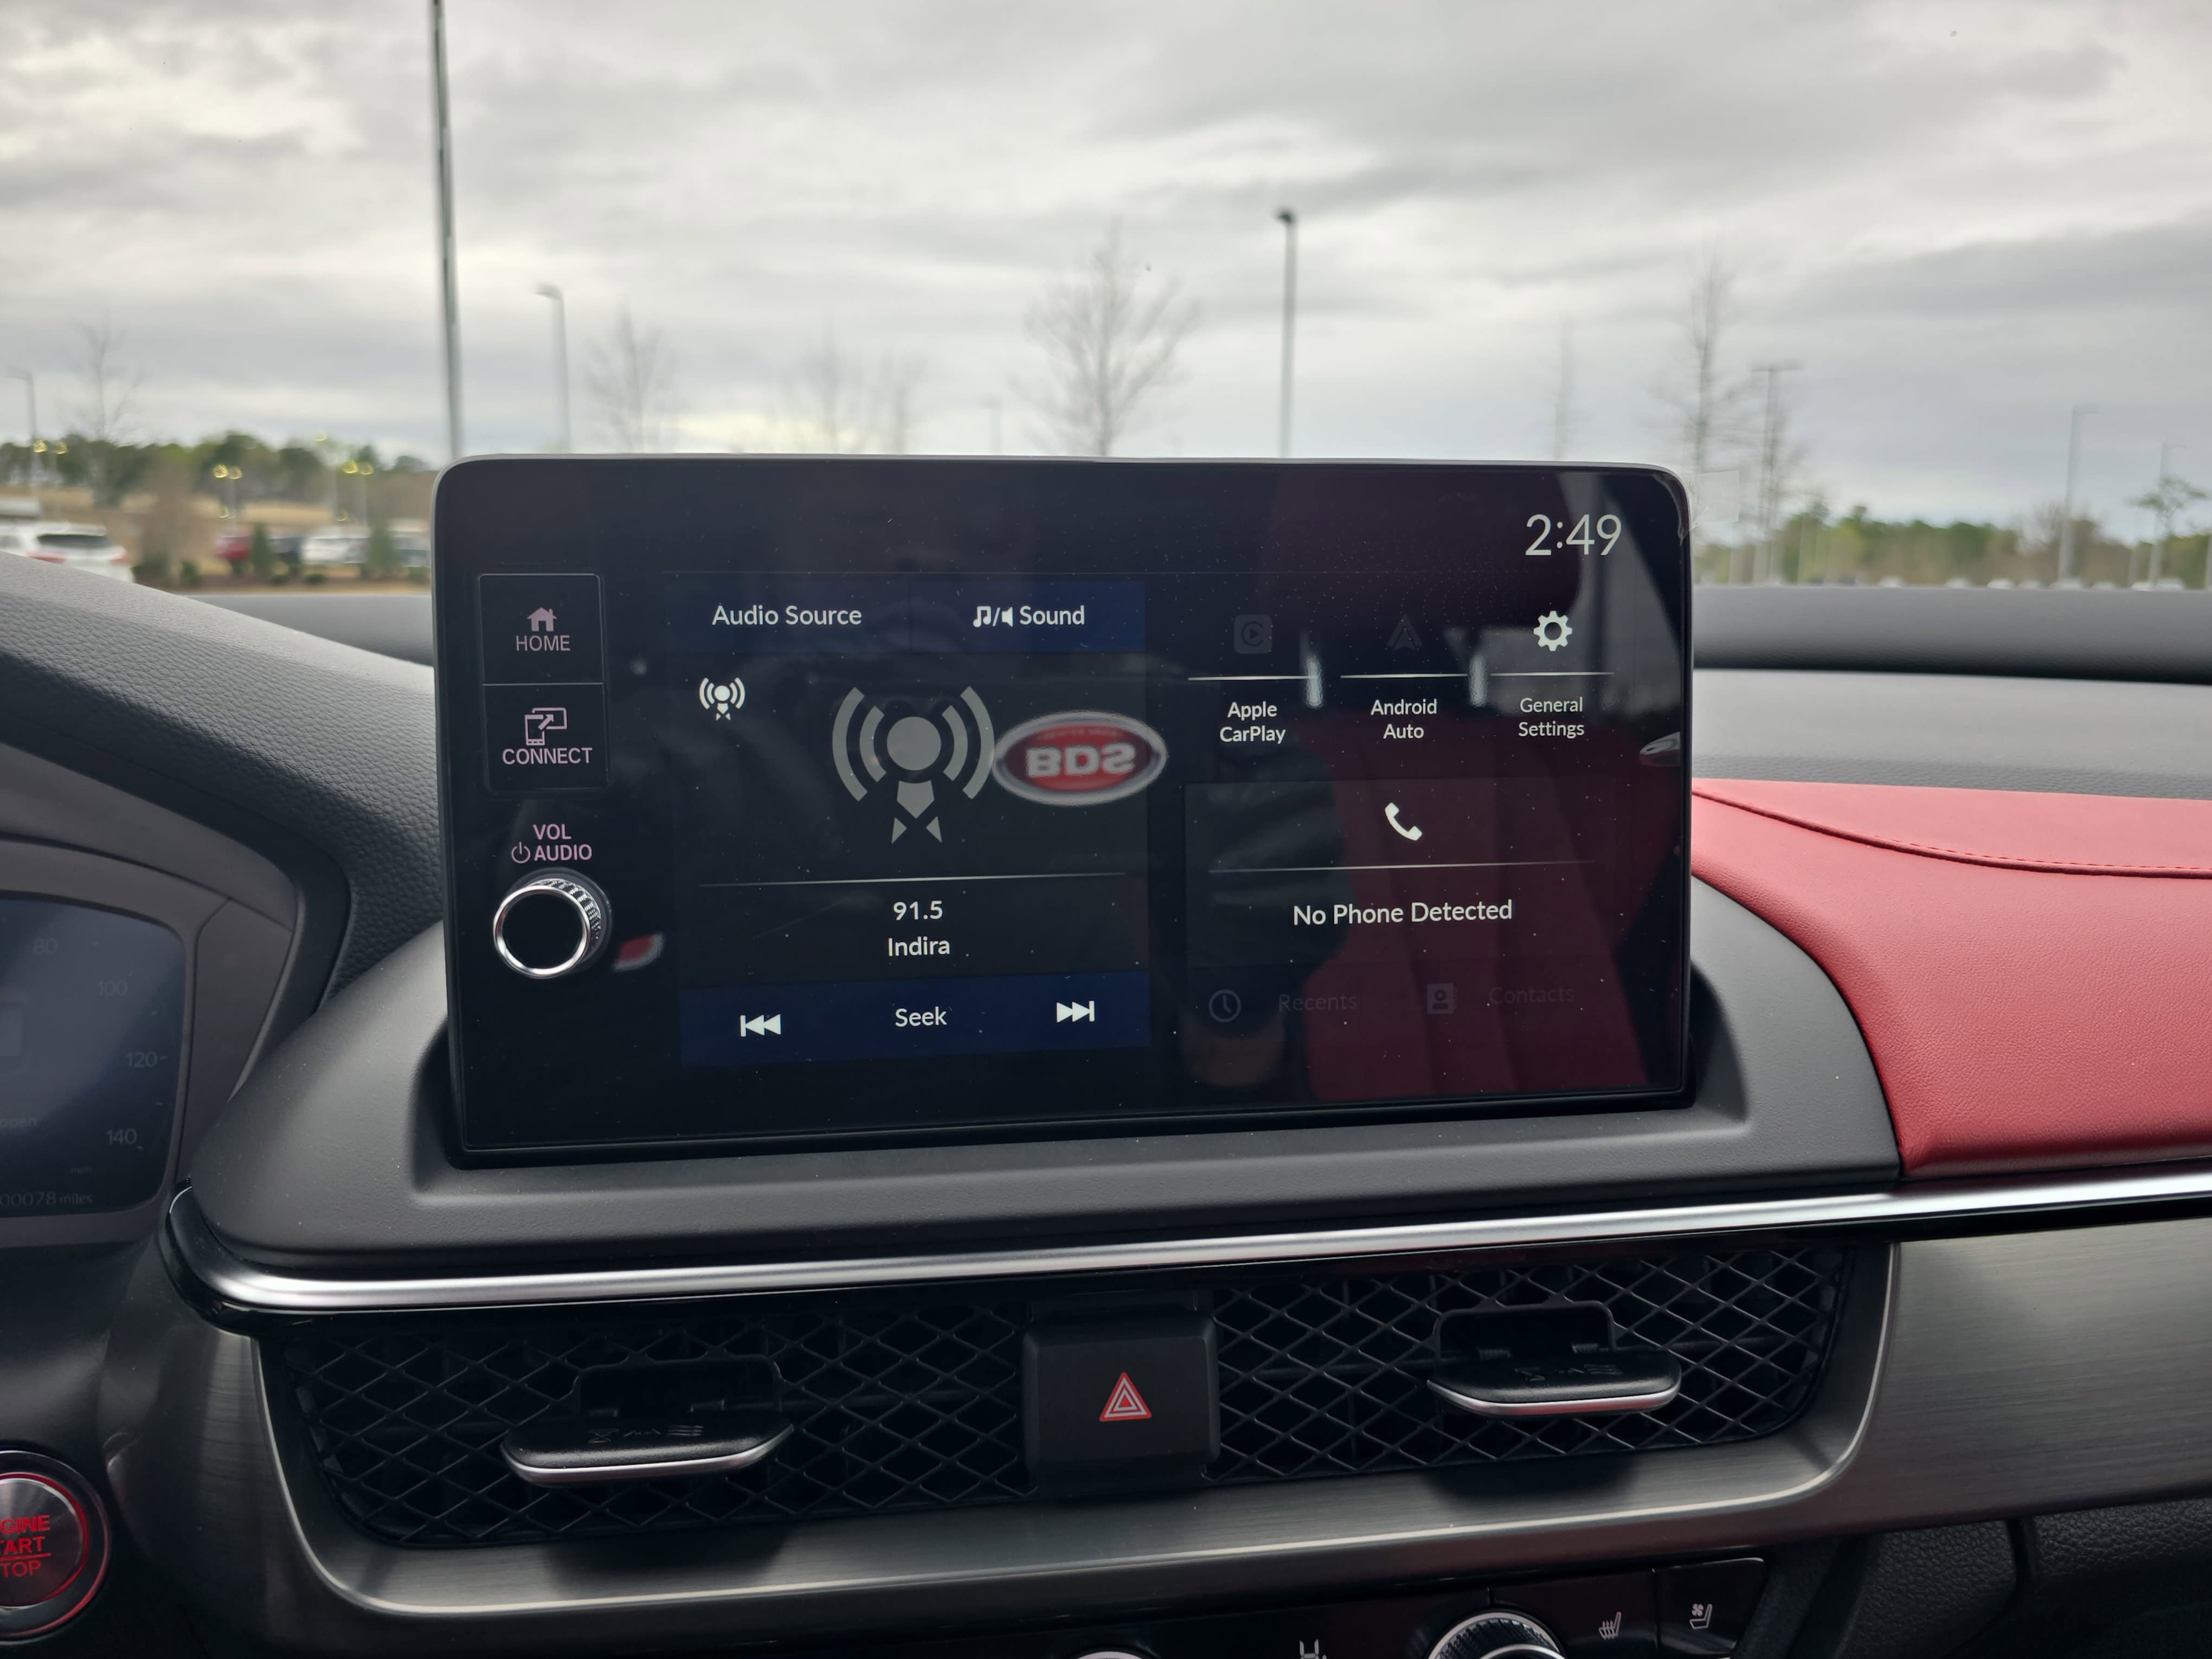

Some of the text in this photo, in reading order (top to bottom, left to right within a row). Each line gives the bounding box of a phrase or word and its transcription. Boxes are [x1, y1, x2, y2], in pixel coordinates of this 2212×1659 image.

[1526, 514, 1622, 555] 2:49
[712, 605, 861, 625] Audio Source
[1020, 606, 1084, 625] Sound
[516, 635, 570, 651] HOME
[1227, 701, 1277, 721] Apple
[1371, 699, 1437, 715] Android
[1520, 697, 1582, 712] General
[1220, 725, 1285, 744] CarPlay
[1384, 724, 1424, 738] Auto
[1519, 721, 1584, 738] Settings
[503, 748, 593, 765] CONNECT
[533, 824, 571, 840] VOL
[535, 844, 591, 861] AUDIO
[893, 901, 942, 920] 91.5
[1294, 899, 1512, 925] No Phone Detected
[889, 936, 950, 956] Indira
[98, 980, 128, 996] 100
[1488, 985, 1575, 1004] Contacts
[1278, 994, 1358, 1012] Recents
[896, 1006, 947, 1027] Seek
[126, 1051, 157, 1067] 120
[106, 1128, 137, 1144] 140
[60, 1193, 92, 1204] miles
